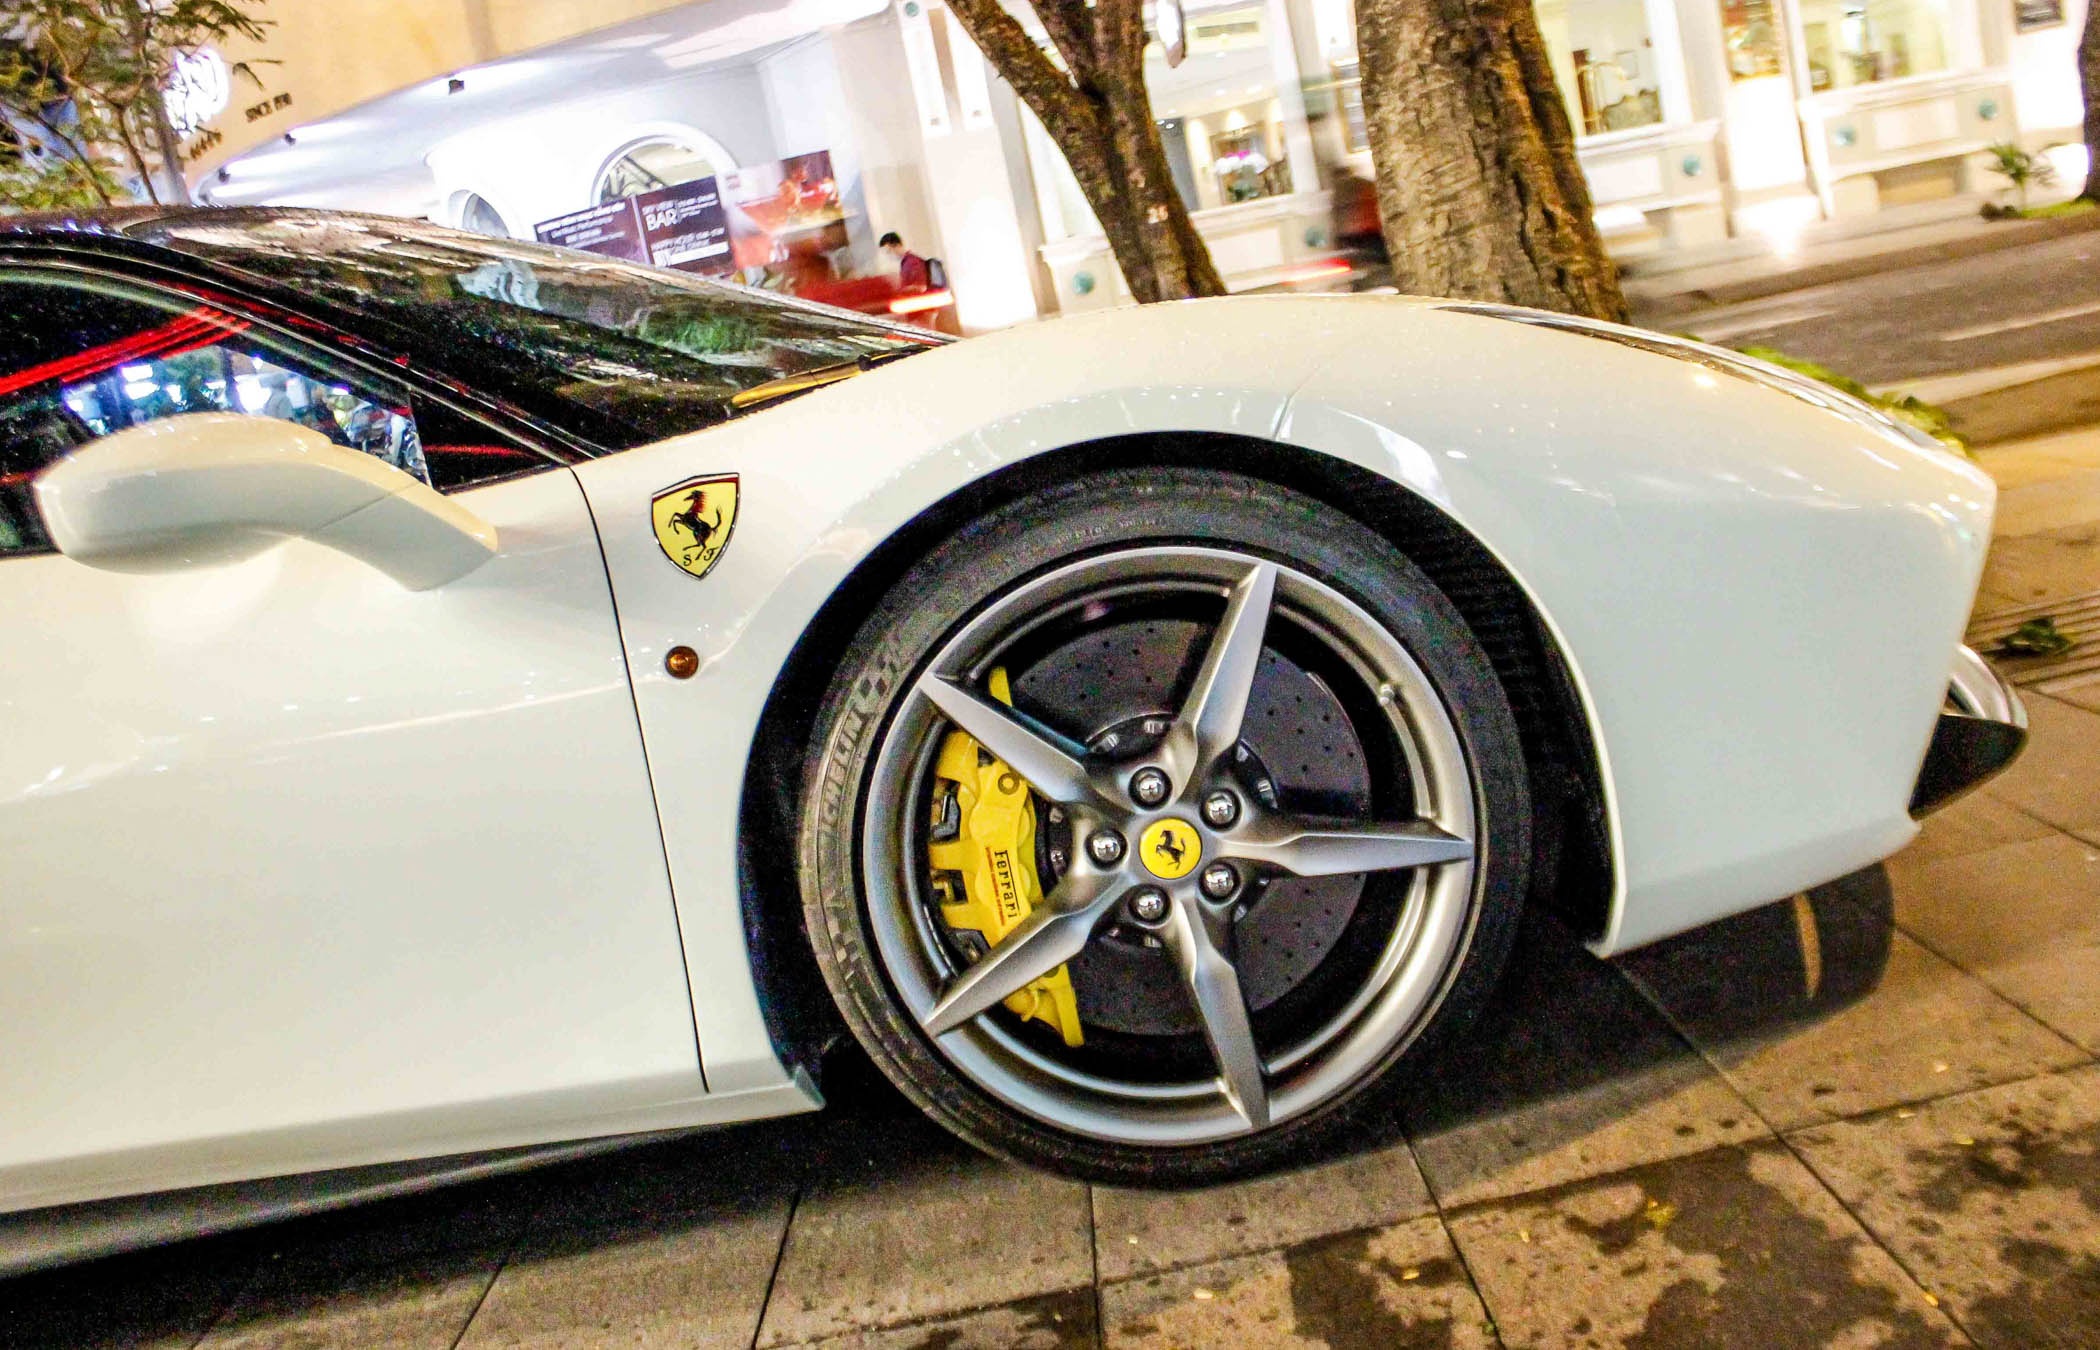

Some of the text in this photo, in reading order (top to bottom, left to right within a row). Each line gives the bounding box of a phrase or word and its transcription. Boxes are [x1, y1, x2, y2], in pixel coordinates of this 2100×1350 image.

[645, 208, 679, 231] BAR
[683, 554, 692, 567] S
[819, 707, 863, 837] ICHELIN
[994, 850, 1020, 918] Ferrari
